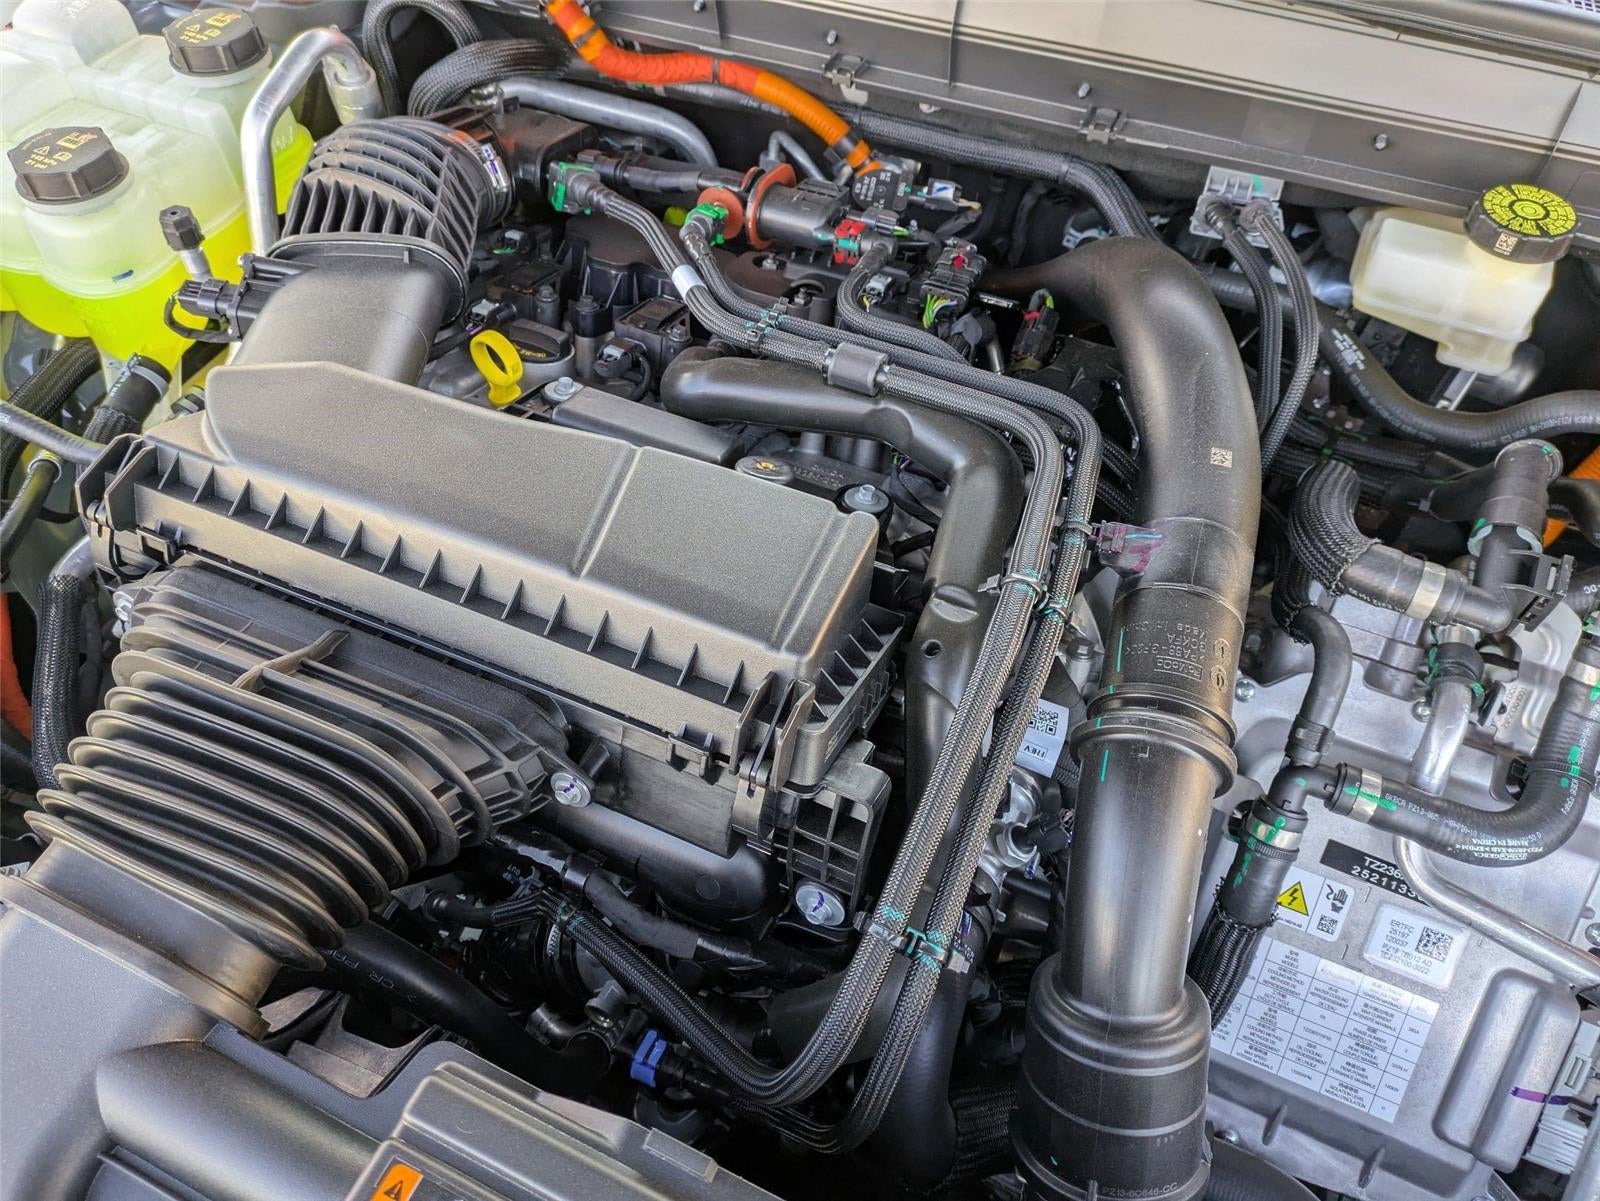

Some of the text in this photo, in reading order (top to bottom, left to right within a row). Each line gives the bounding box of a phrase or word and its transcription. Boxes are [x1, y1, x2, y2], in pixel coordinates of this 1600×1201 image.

[1470, 835, 1496, 847] CHINA
[1361, 856, 1406, 880] TZ236
[1349, 864, 1426, 900] 2521133
